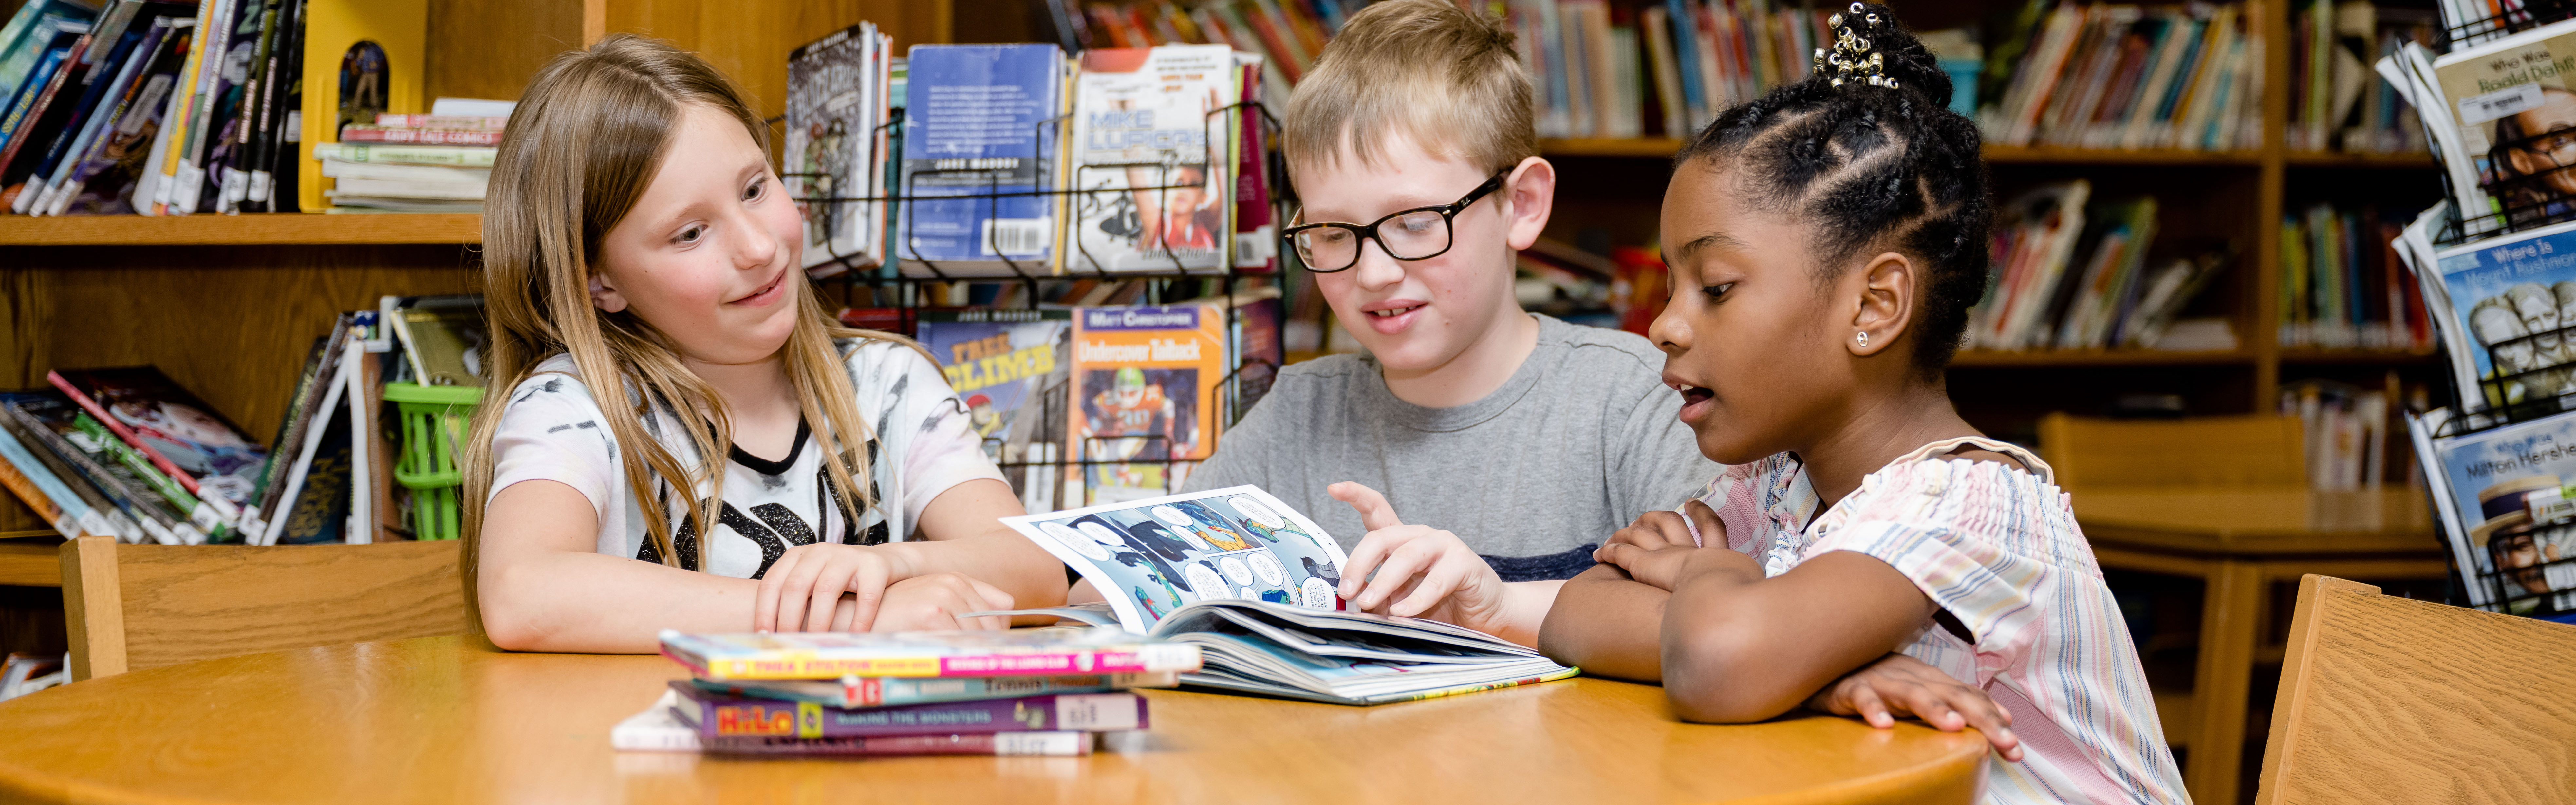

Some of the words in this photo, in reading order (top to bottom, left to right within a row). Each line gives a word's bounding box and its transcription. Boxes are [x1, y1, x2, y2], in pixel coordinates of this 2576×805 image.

[2490, 57, 2521, 73] Who
[2477, 68, 2529, 93] Roald
[1089, 109, 1155, 130] MIKE
[420, 130, 445, 143] TALE
[446, 131, 493, 145] COMICS
[934, 158, 967, 170] JAKE
[969, 157, 1019, 169] MADDOX
[2491, 245, 2537, 264] Where
[2536, 238, 2554, 255] Is
[2464, 264, 2512, 286] Mount
[958, 311, 988, 322] JAKE
[992, 310, 1042, 321] MADDOX
[951, 331, 1013, 364] FREE
[1078, 341, 1150, 362] Undercover
[1150, 338, 1201, 361] Tailback
[943, 343, 1055, 393] CLIMB
[2495, 441, 2523, 454] Who
[2465, 458, 2517, 481] Milton
[984, 677, 1043, 692] Tennis
